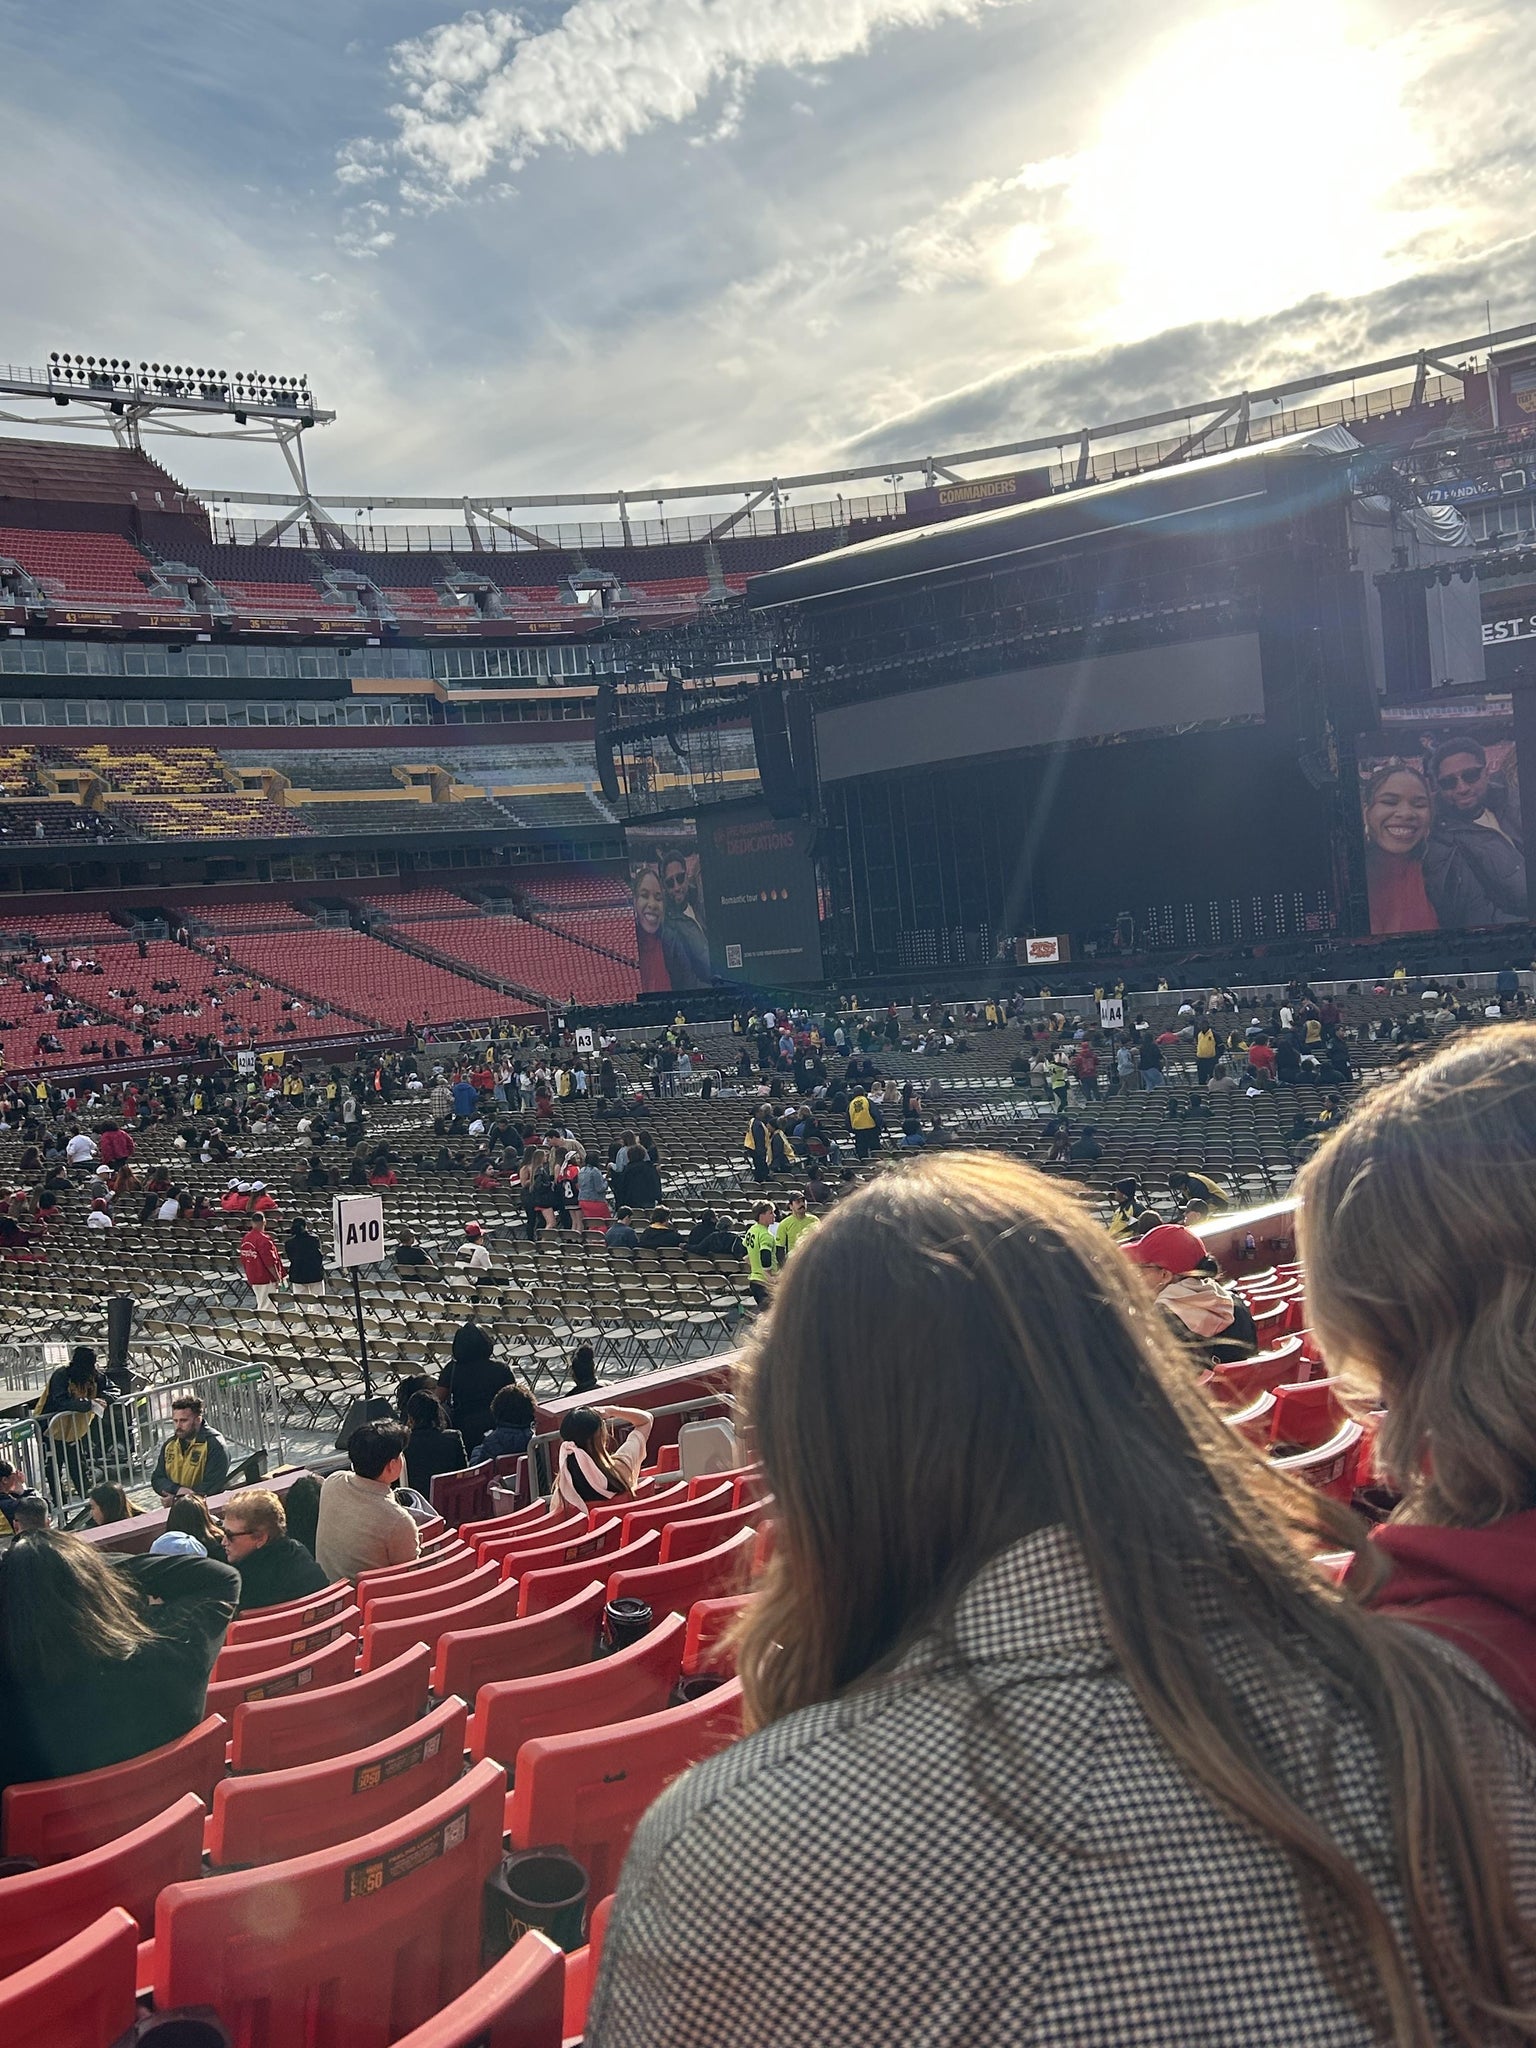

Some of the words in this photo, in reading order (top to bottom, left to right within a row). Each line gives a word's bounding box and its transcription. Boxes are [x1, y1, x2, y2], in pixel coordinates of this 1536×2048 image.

[939, 479, 1016, 504] COMMANDERS
[66, 612, 77, 623] 43
[150, 616, 159, 626] 17
[249, 619, 260, 629] 35
[320, 622, 331, 631] 30
[528, 623, 537, 632] 41
[721, 895, 746, 905] Romantic
[1110, 1007, 1121, 1021] A4
[578, 1035, 592, 1047] A3
[346, 1219, 380, 1245] A10
